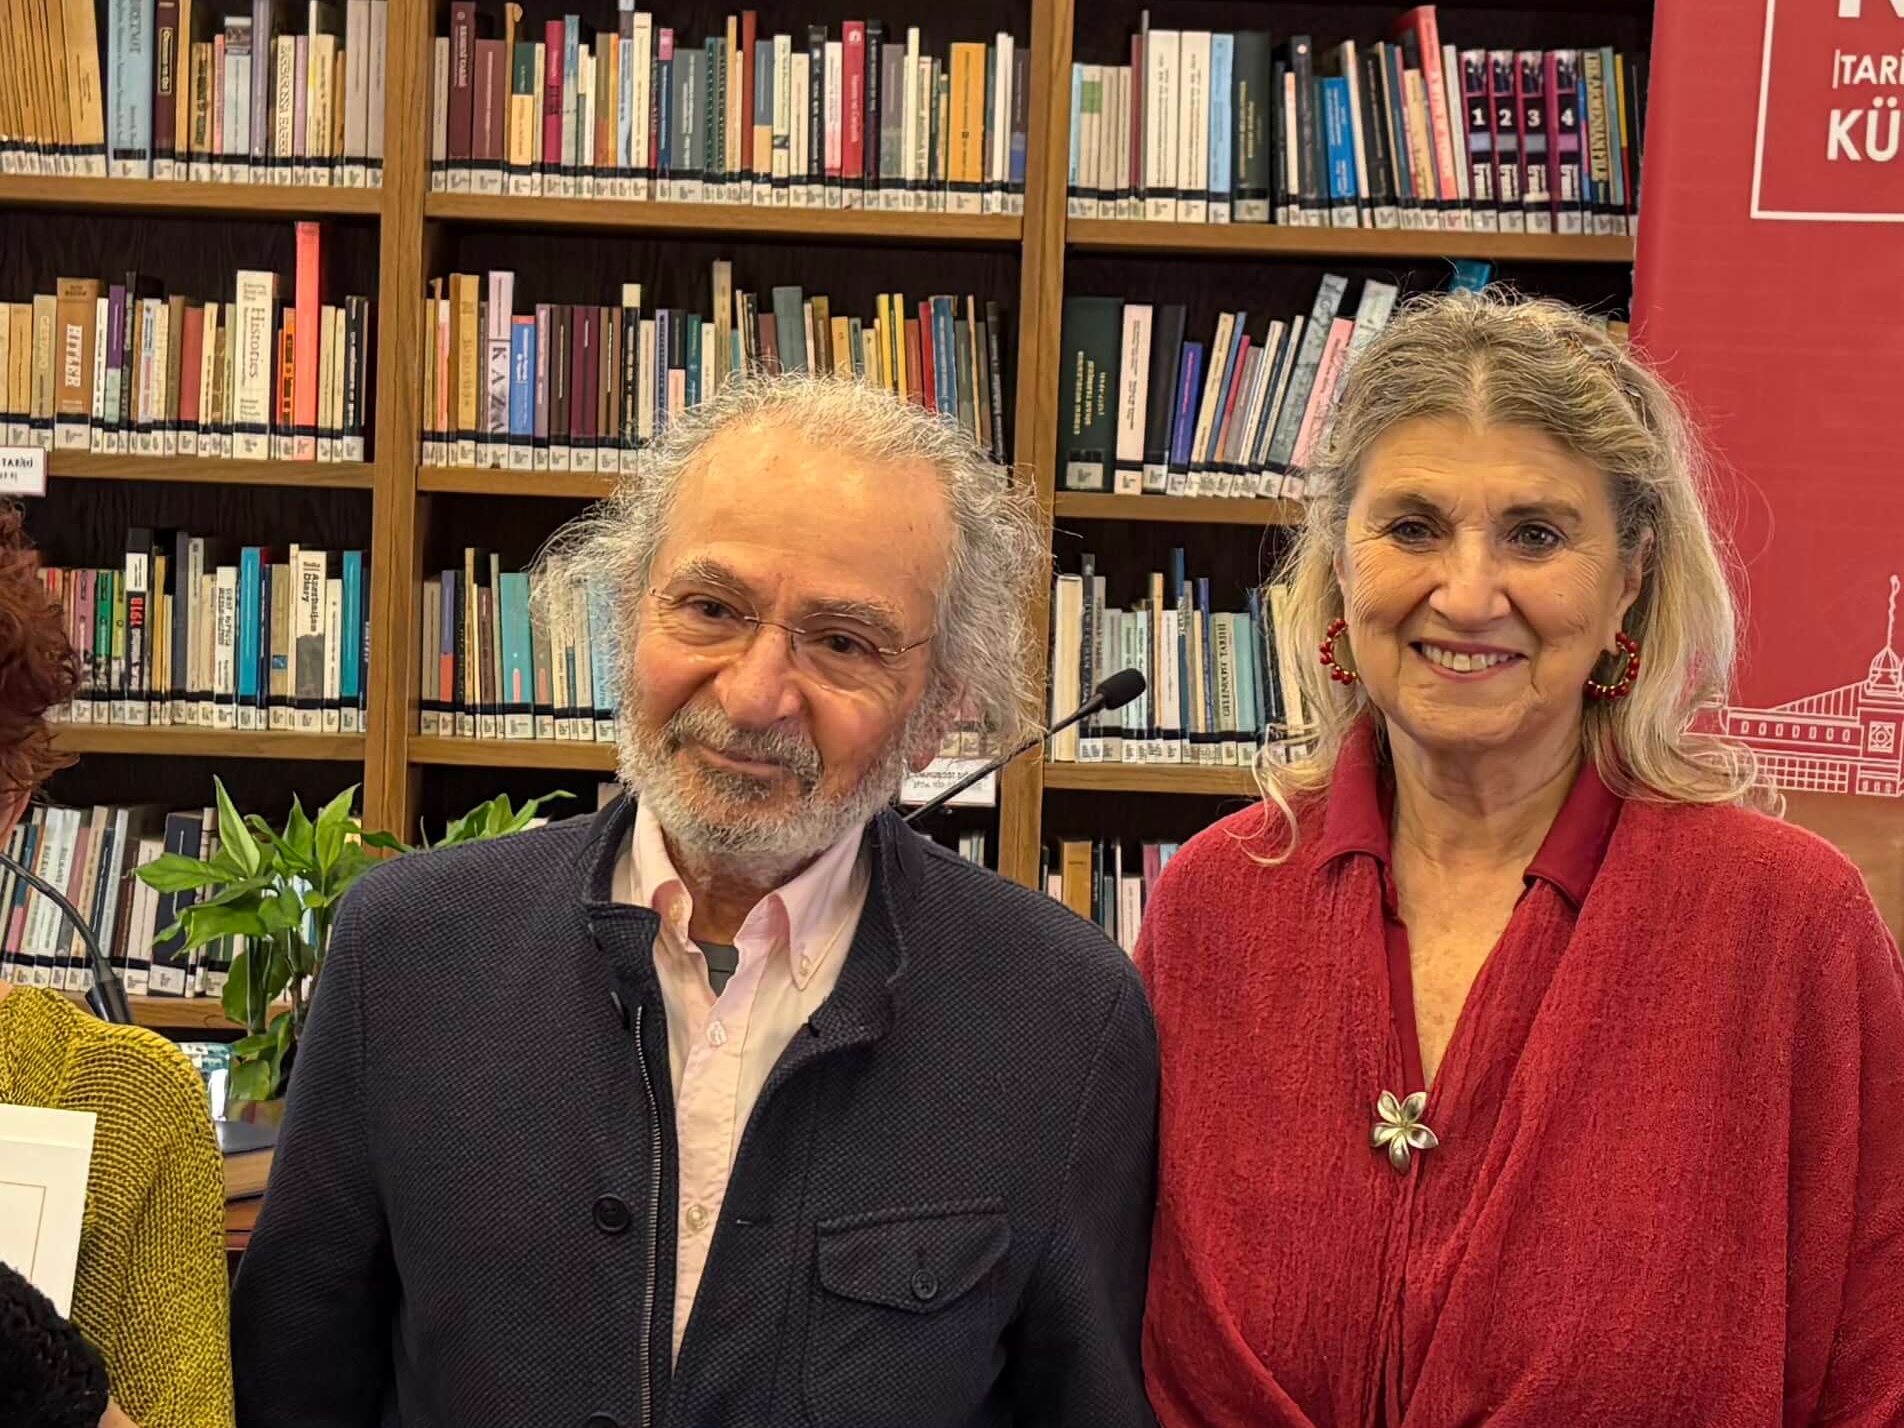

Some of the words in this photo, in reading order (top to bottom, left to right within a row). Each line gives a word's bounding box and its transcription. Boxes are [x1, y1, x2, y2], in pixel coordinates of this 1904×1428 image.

[1472, 108, 1486, 127] 1
[1499, 108, 1513, 127] 2
[1527, 108, 1541, 128] 3
[1561, 108, 1575, 127] 4
[64, 324, 83, 387] HITLER
[248, 308, 265, 380] Histories
[130, 597, 144, 626] 1918
[309, 572, 320, 632] Azerbaijan
